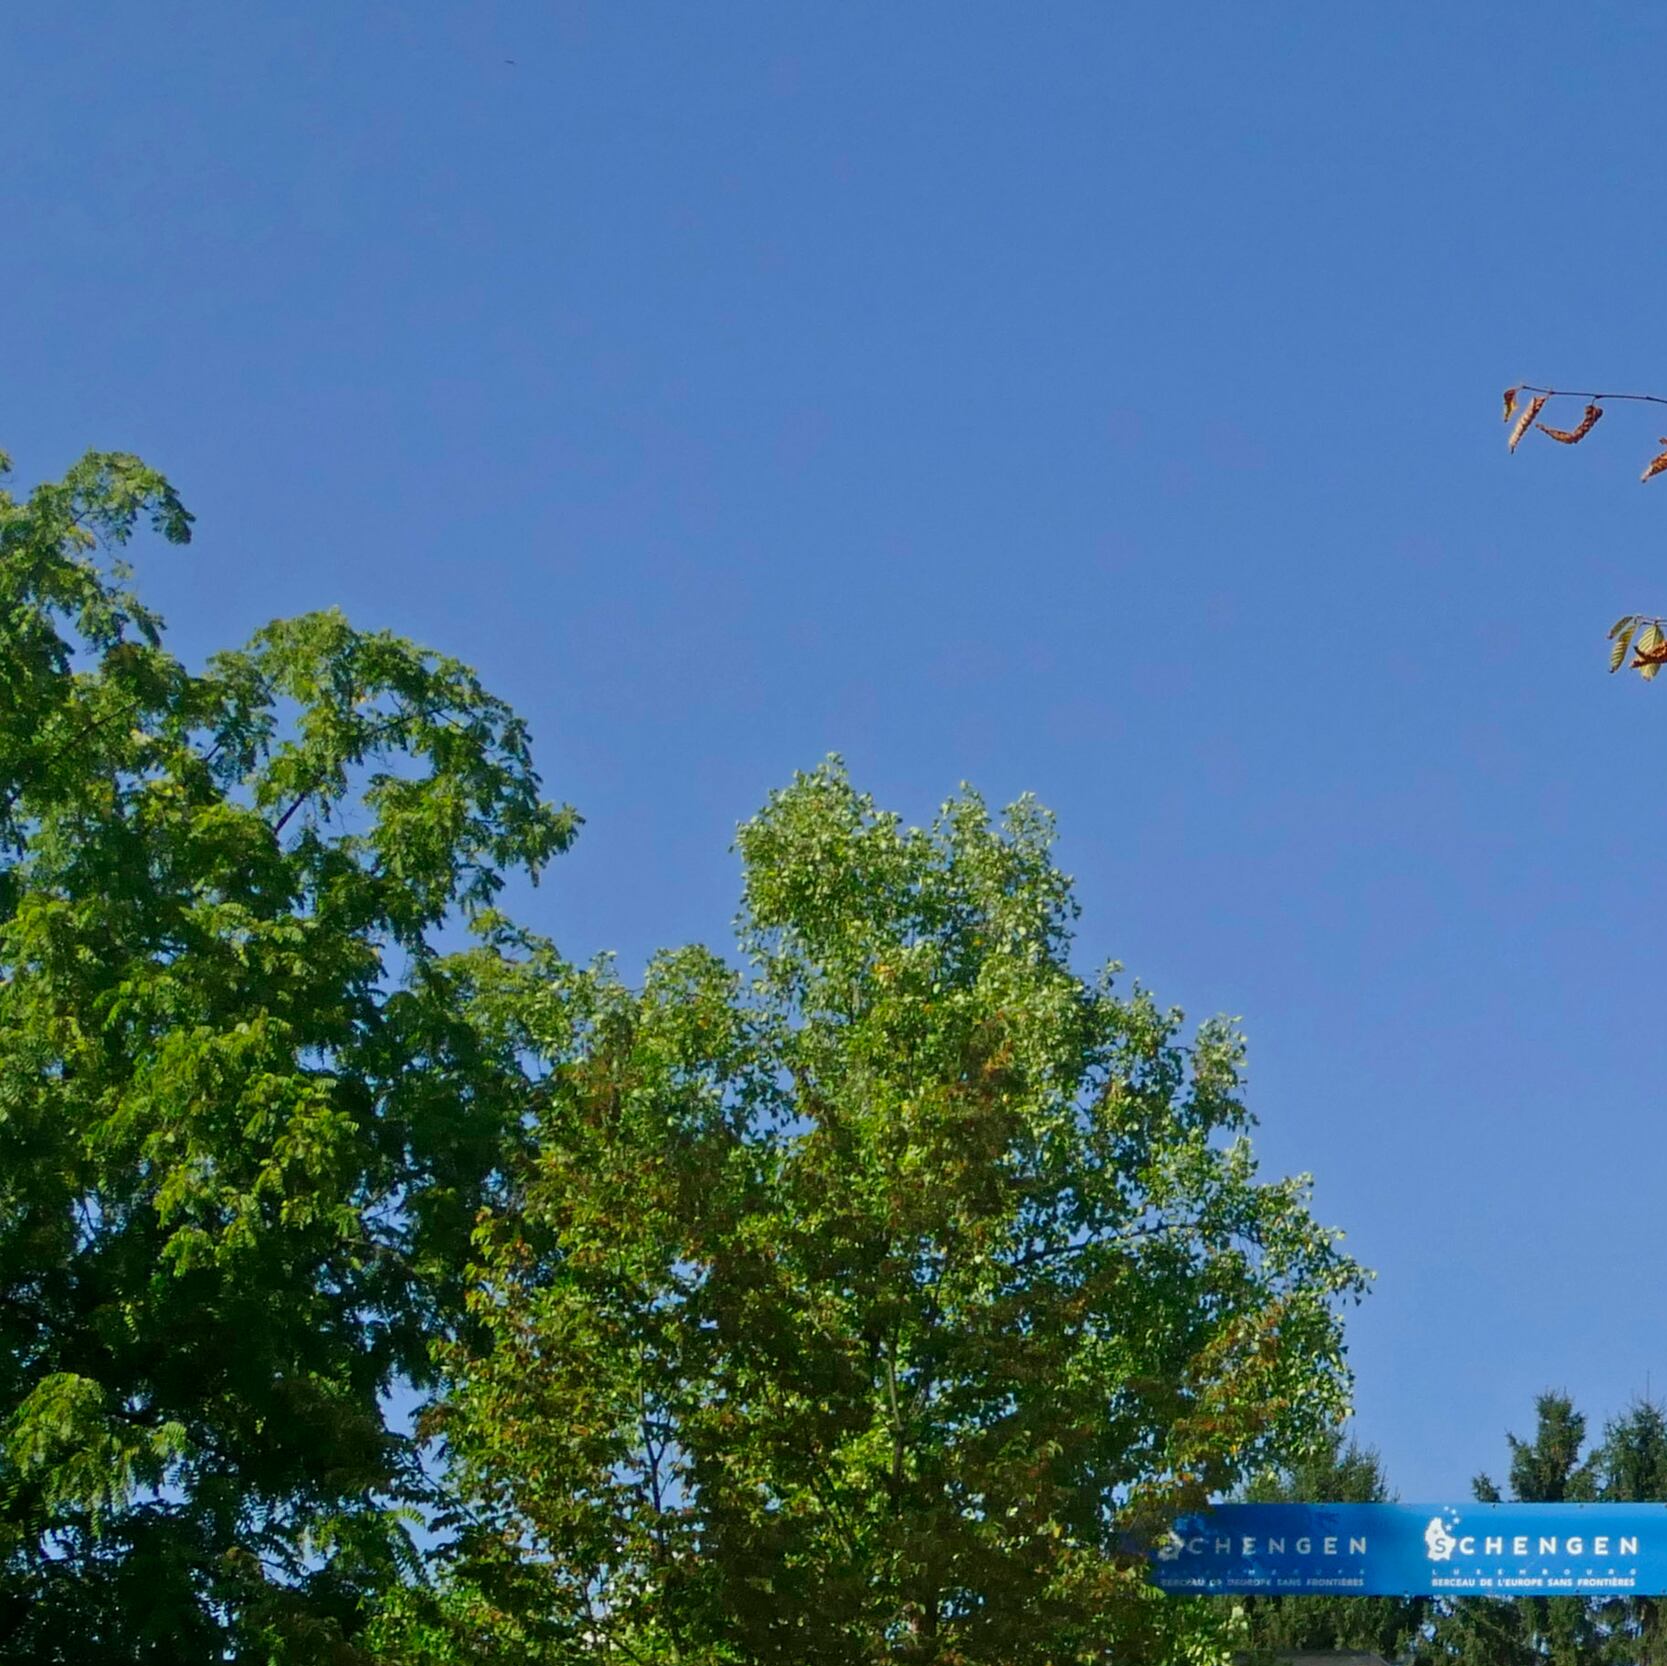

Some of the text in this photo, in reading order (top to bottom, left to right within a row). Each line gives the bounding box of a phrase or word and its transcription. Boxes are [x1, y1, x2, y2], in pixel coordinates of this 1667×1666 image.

[1435, 1537, 1638, 1555] SCHENGEN
[1432, 1577, 1475, 1587] BERCEAU
[1480, 1577, 1492, 1587] DE
[1498, 1577, 1543, 1587] L'EUROPE
[1548, 1577, 1573, 1587] SANS
